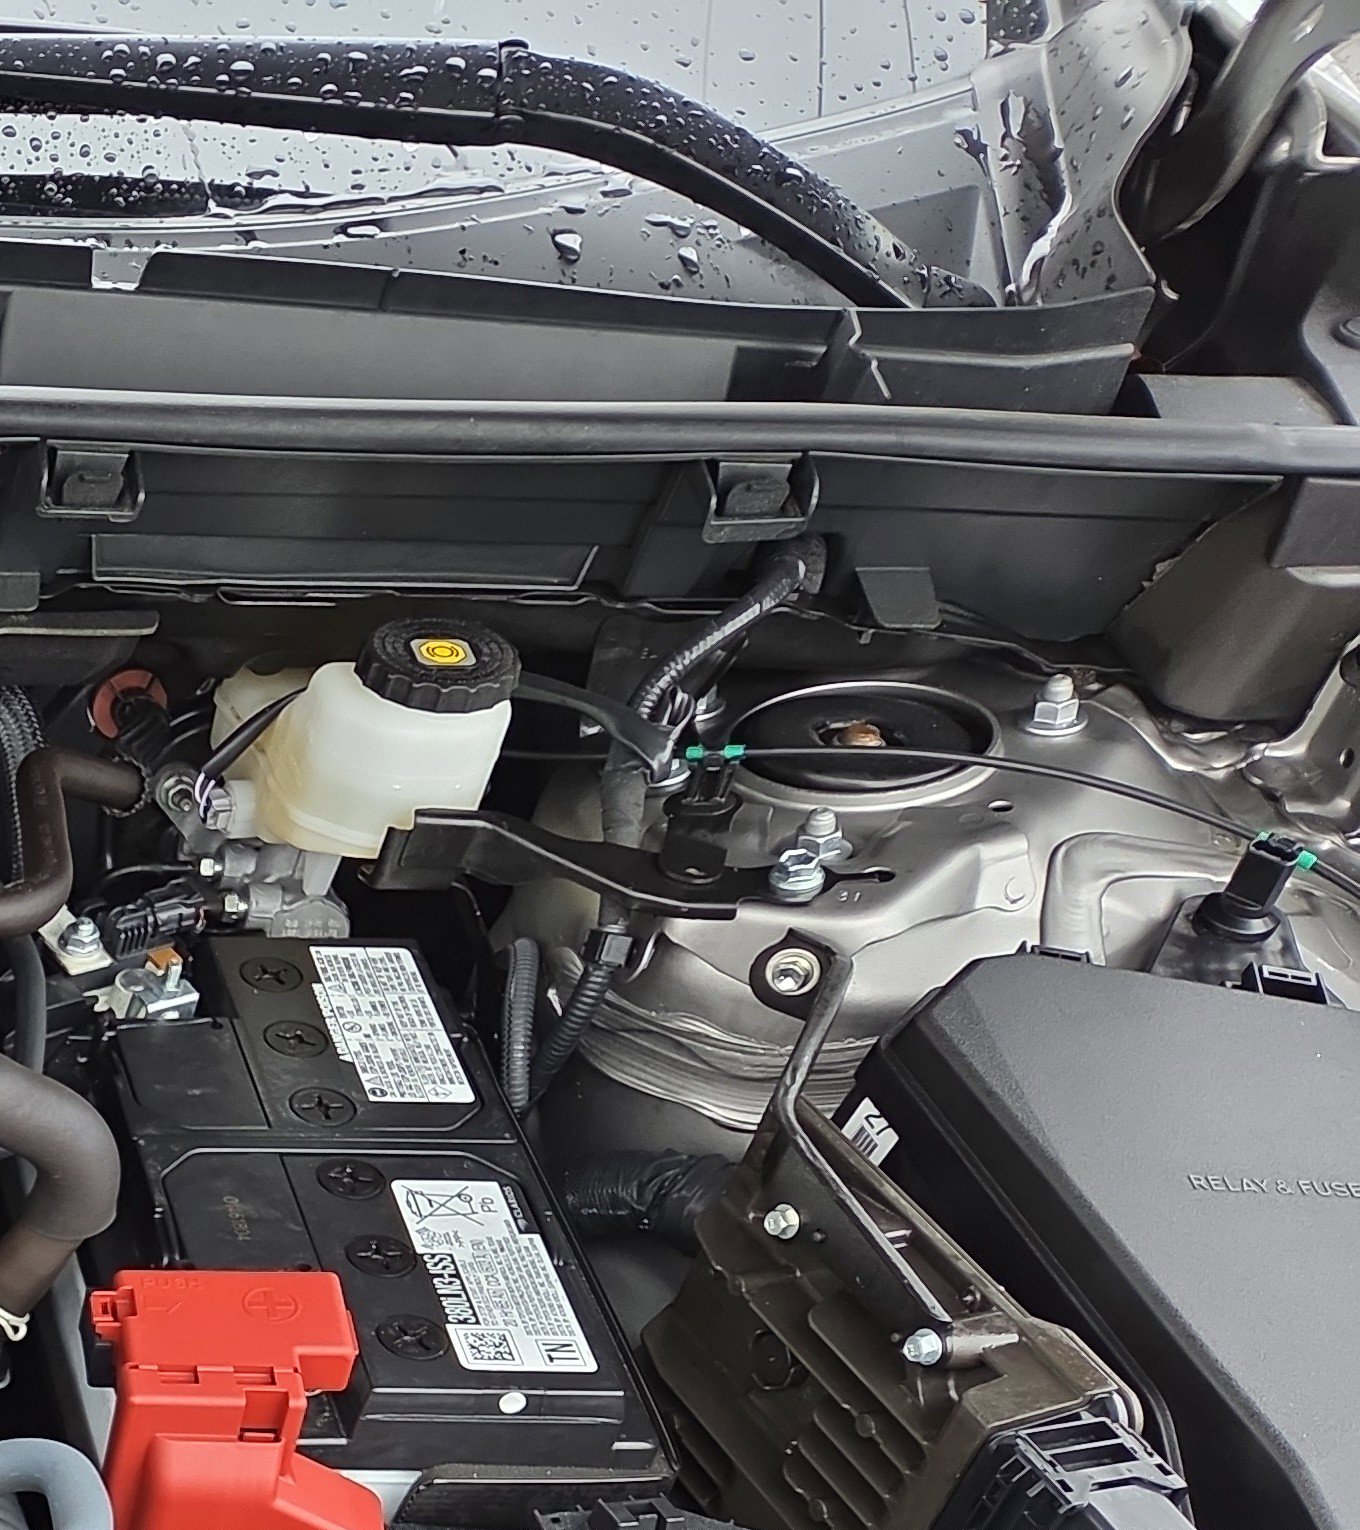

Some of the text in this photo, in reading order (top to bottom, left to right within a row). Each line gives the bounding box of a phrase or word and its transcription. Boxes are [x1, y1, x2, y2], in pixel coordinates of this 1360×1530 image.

[1187, 1173, 1360, 1199] RELAY & FUSE
[480, 1196, 500, 1214] Pb
[541, 1342, 581, 1364] TN
